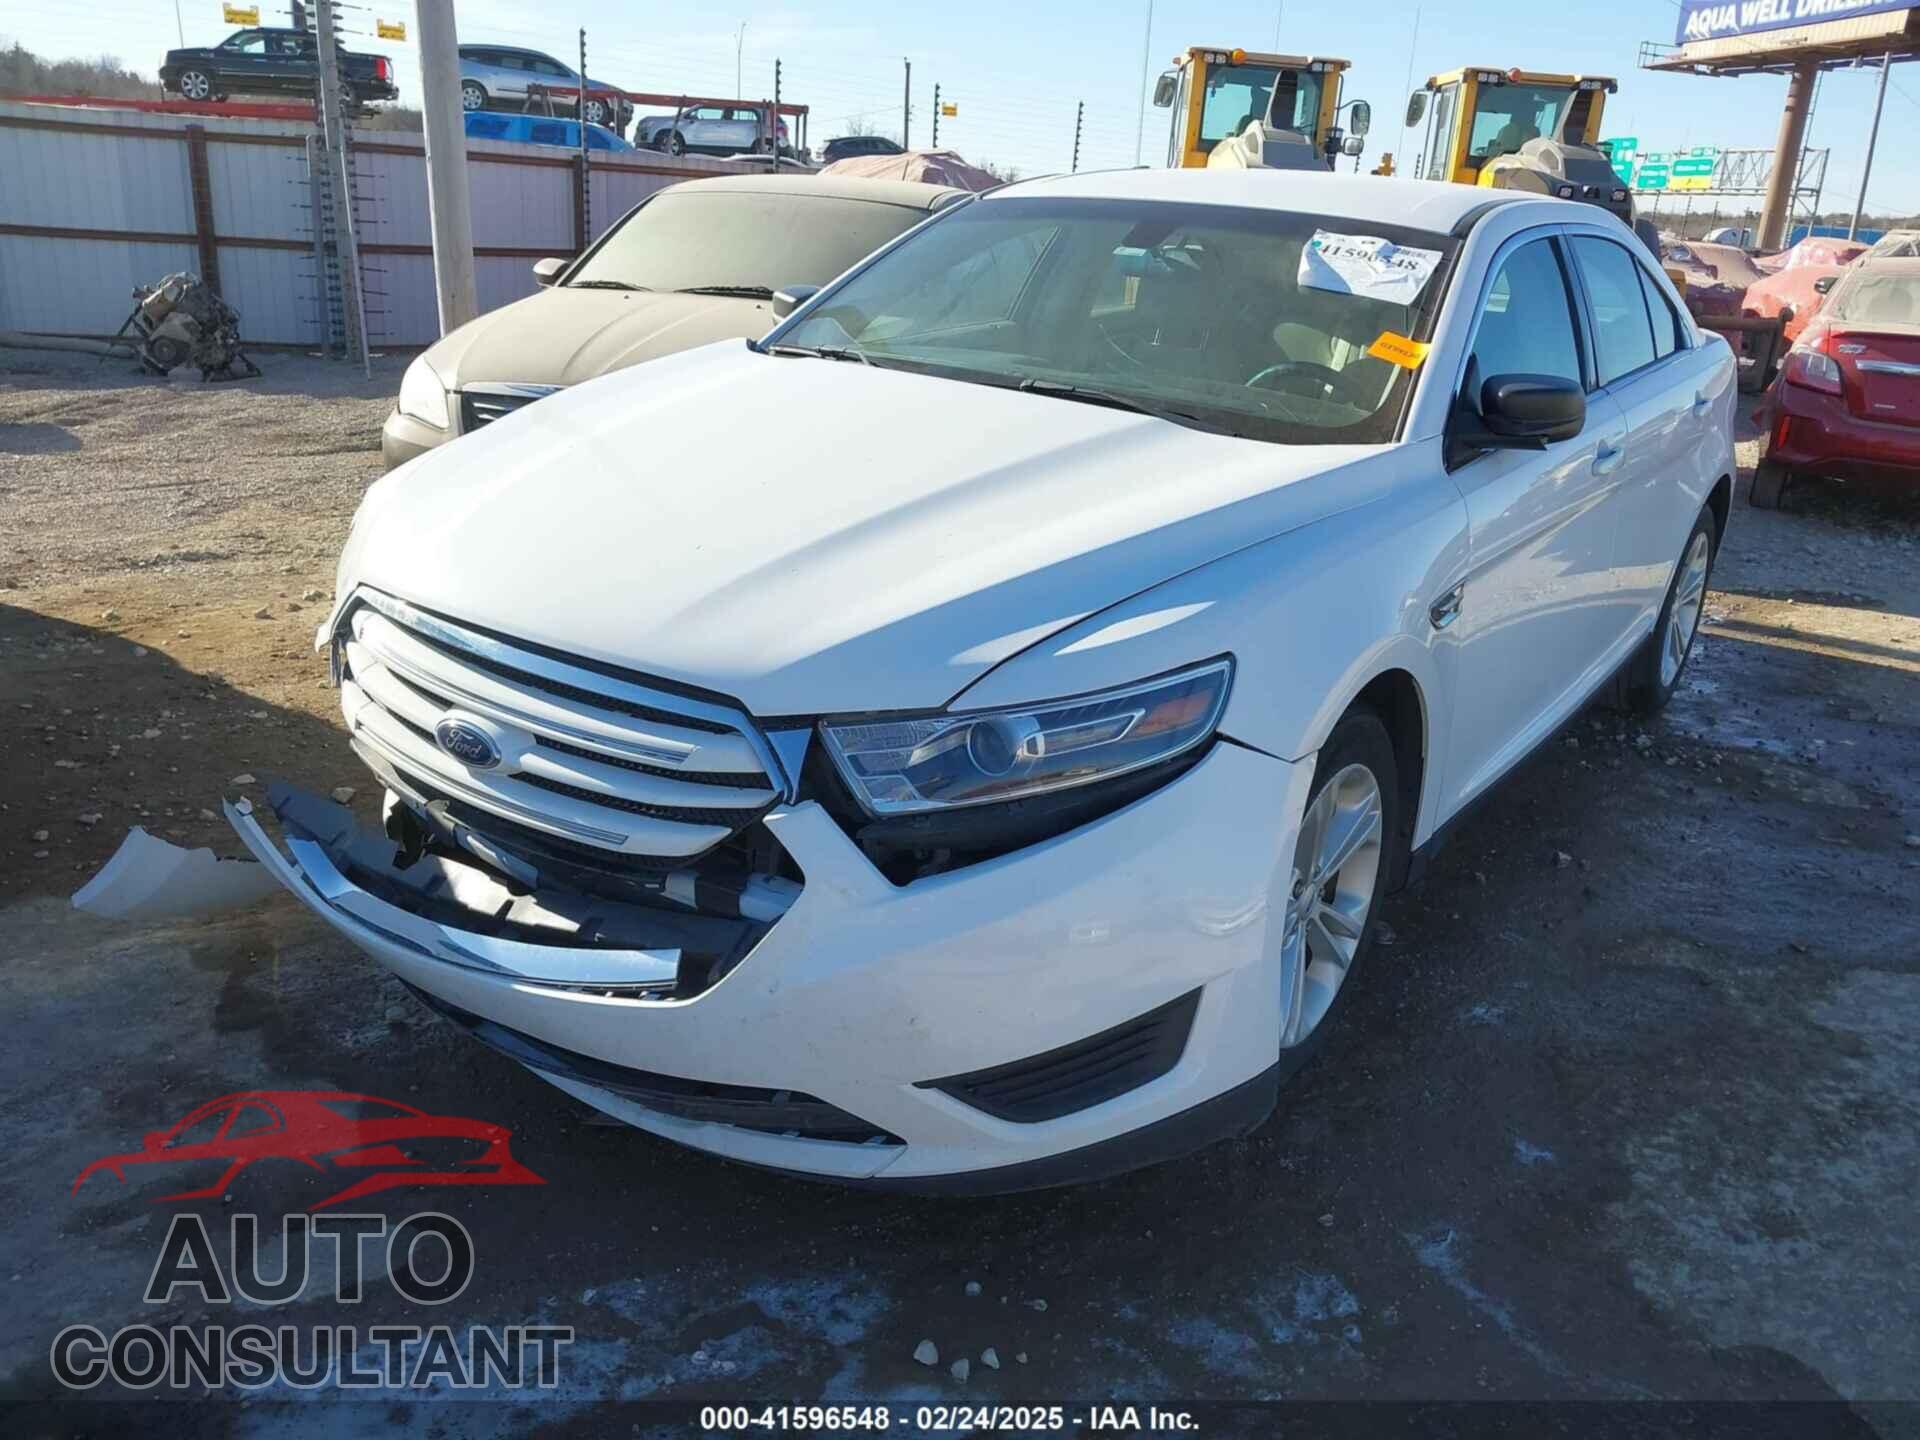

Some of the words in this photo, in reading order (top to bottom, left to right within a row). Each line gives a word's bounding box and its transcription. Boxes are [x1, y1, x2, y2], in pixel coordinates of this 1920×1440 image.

[1684, 4, 1739, 37] AQUA
[1742, 0, 1791, 27] WELL
[447, 729, 482, 759] Ford
